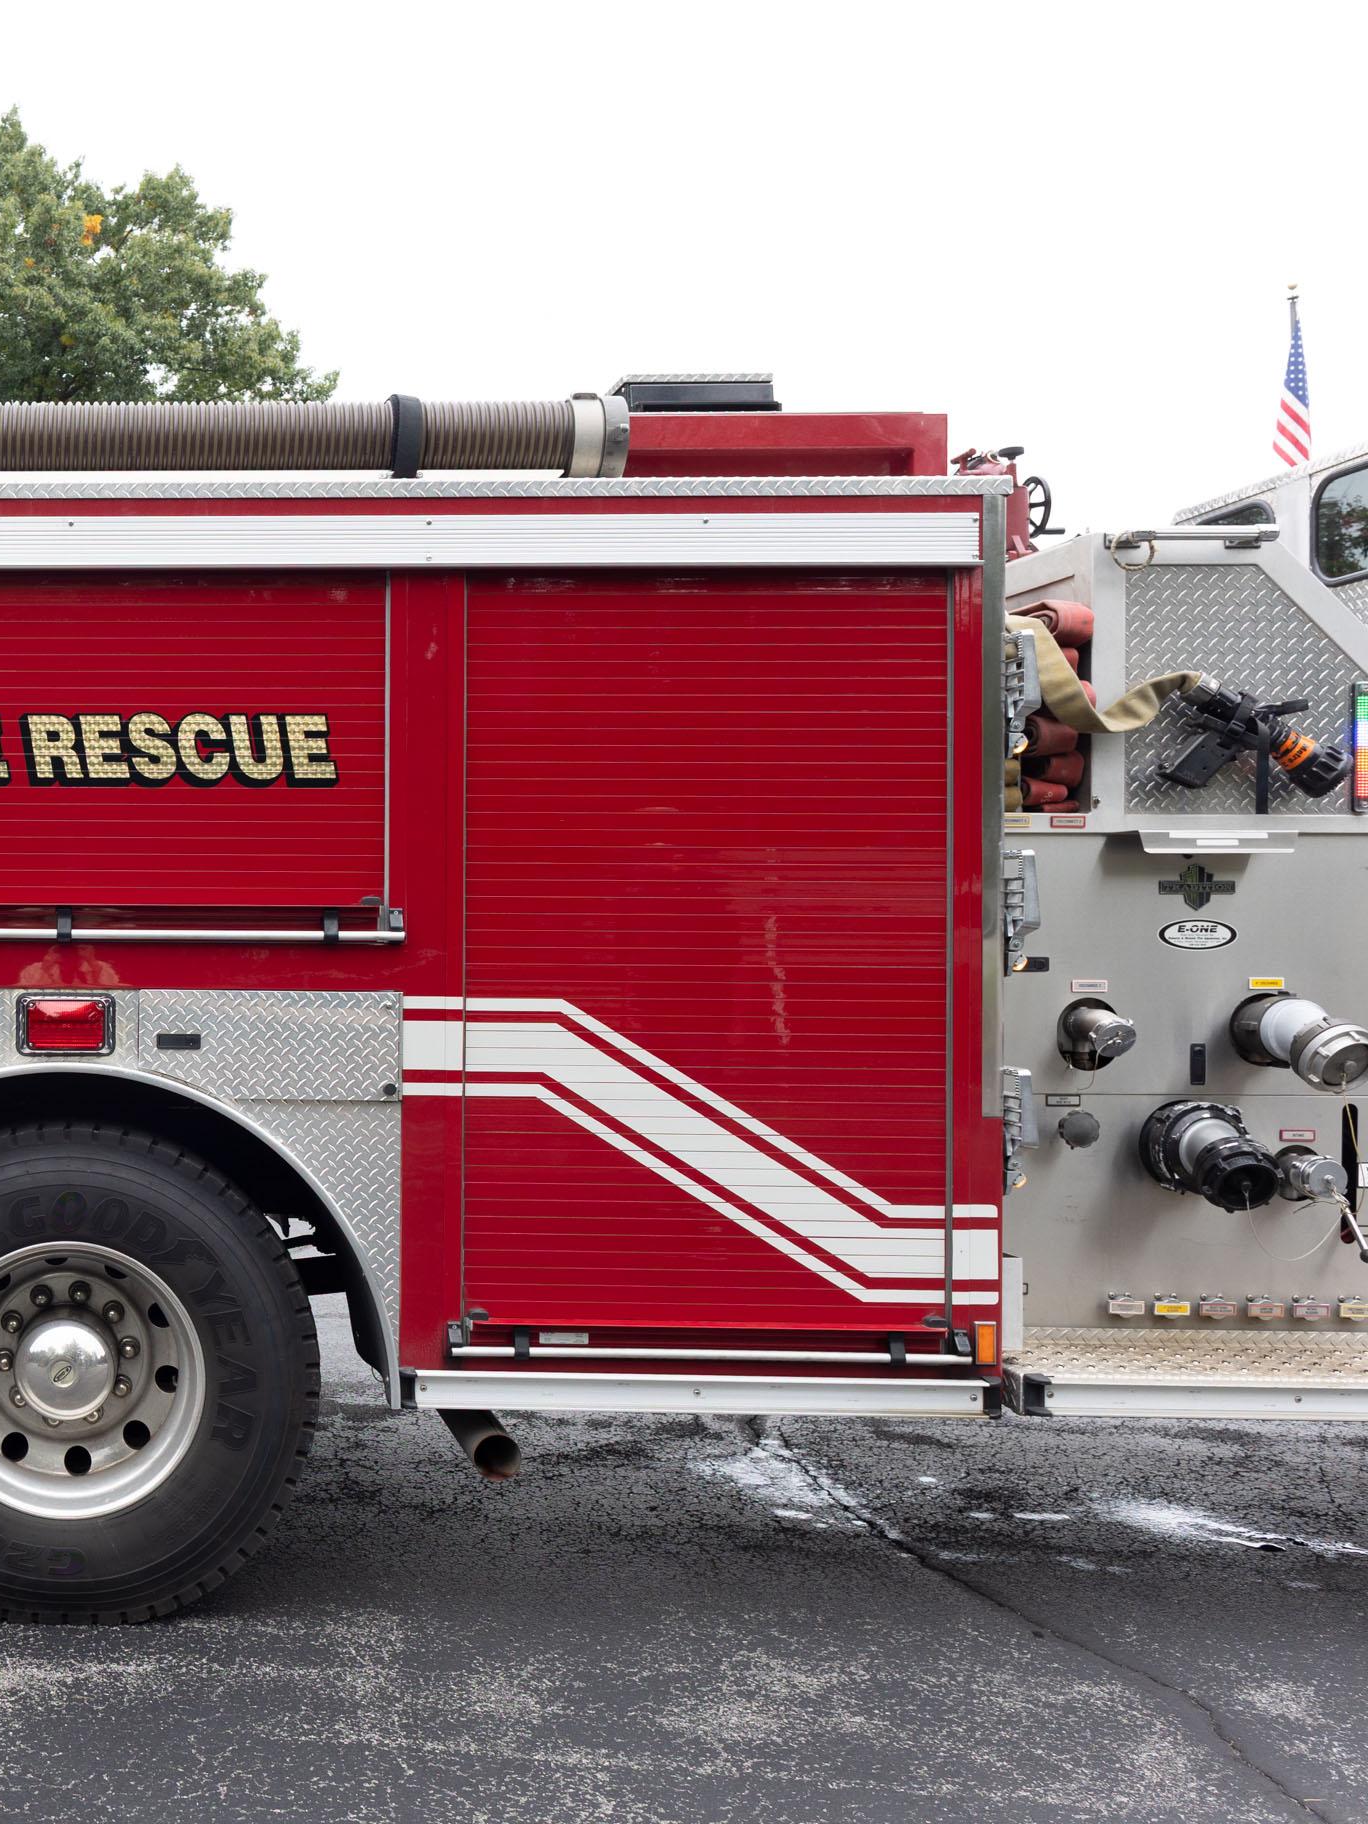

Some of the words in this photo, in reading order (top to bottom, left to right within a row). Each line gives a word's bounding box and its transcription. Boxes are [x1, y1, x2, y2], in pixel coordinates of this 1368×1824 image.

[21, 712, 338, 787] RESCUE
[1177, 924, 1218, 933] E-ONE
[7, 1190, 258, 1452] GOODYEAR
